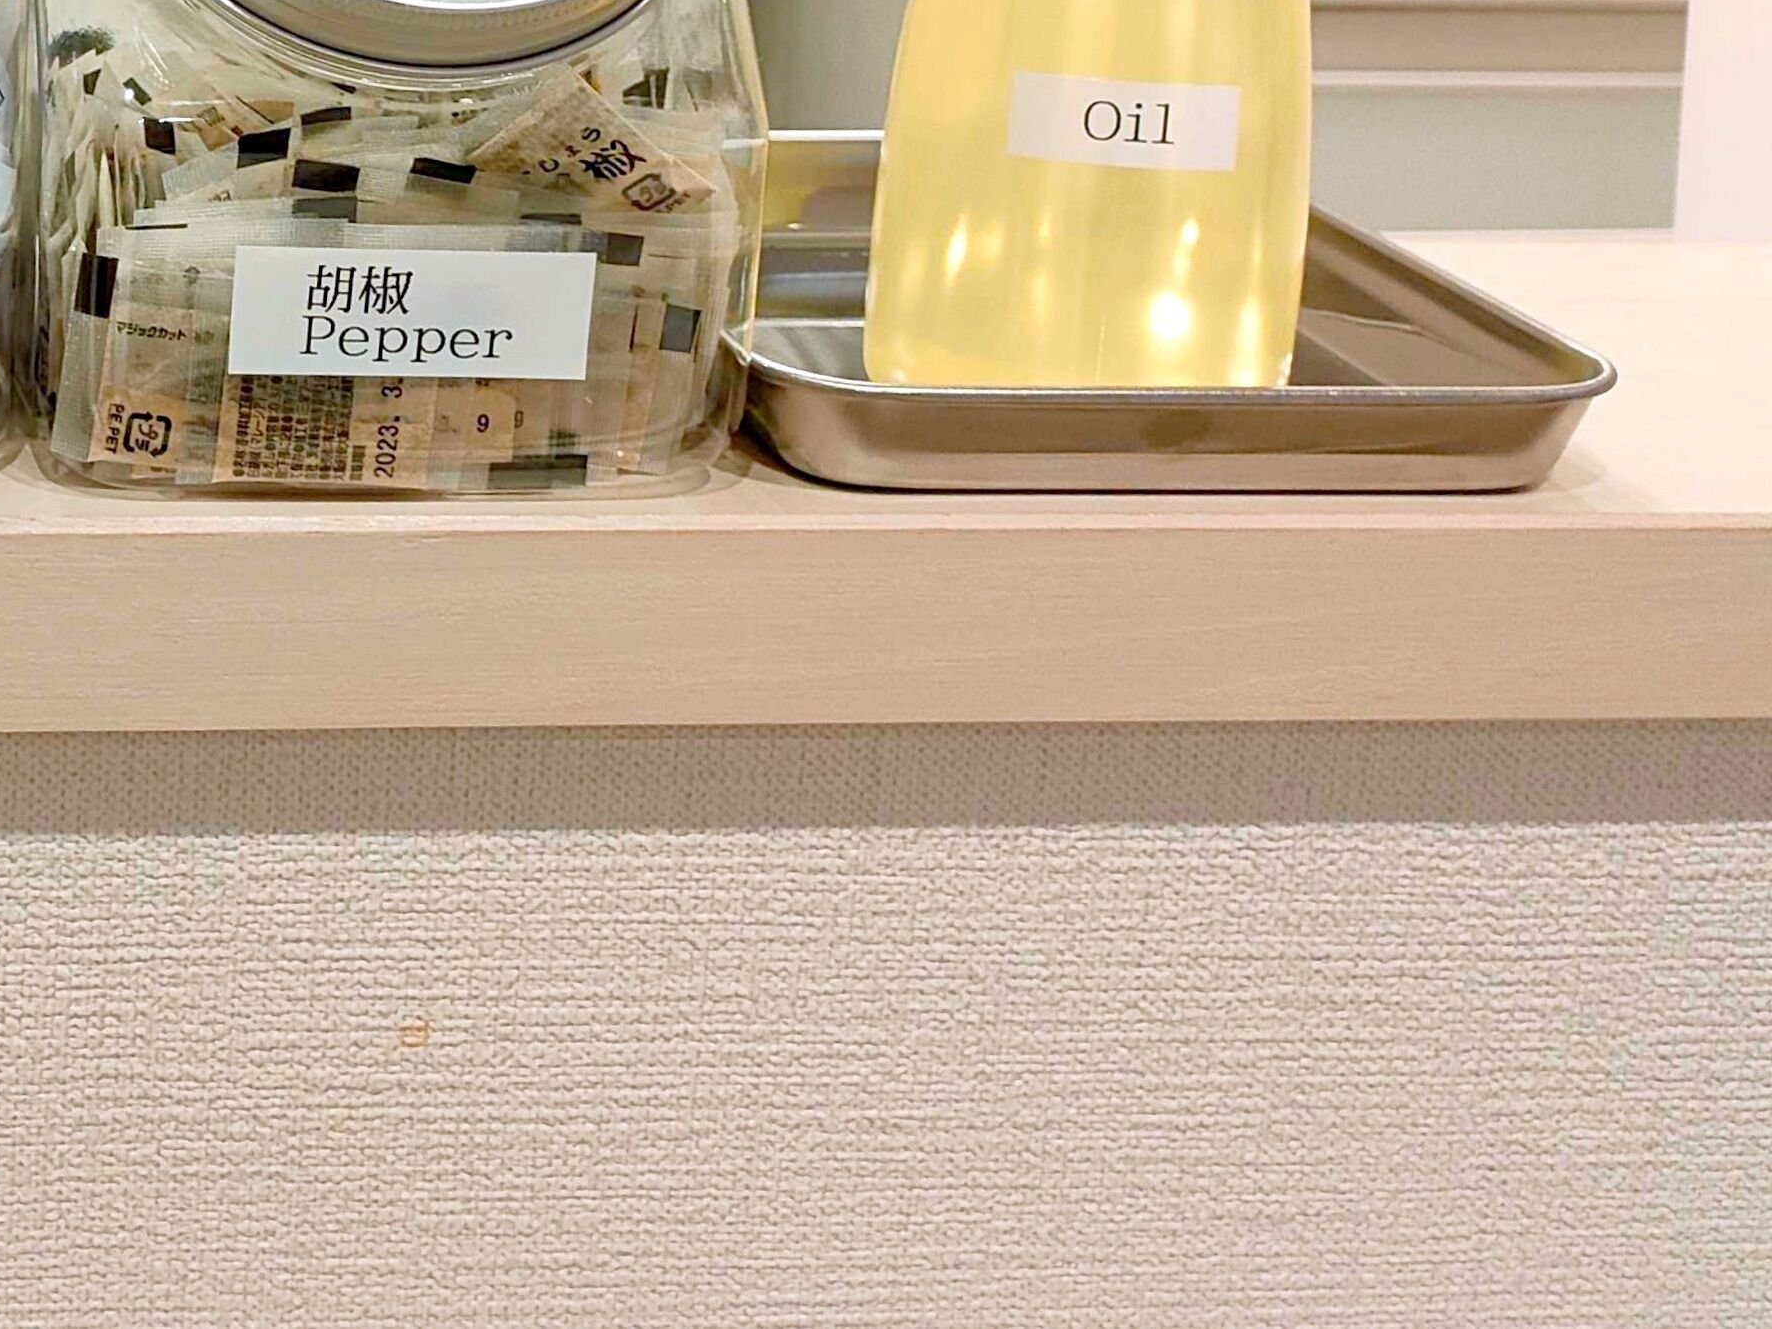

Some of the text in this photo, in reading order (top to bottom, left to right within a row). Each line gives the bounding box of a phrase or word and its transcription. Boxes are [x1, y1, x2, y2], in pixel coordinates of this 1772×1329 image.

[1083, 100, 1174, 145] Oil
[306, 264, 413, 315] 胡椒
[300, 315, 513, 363] Pepper
